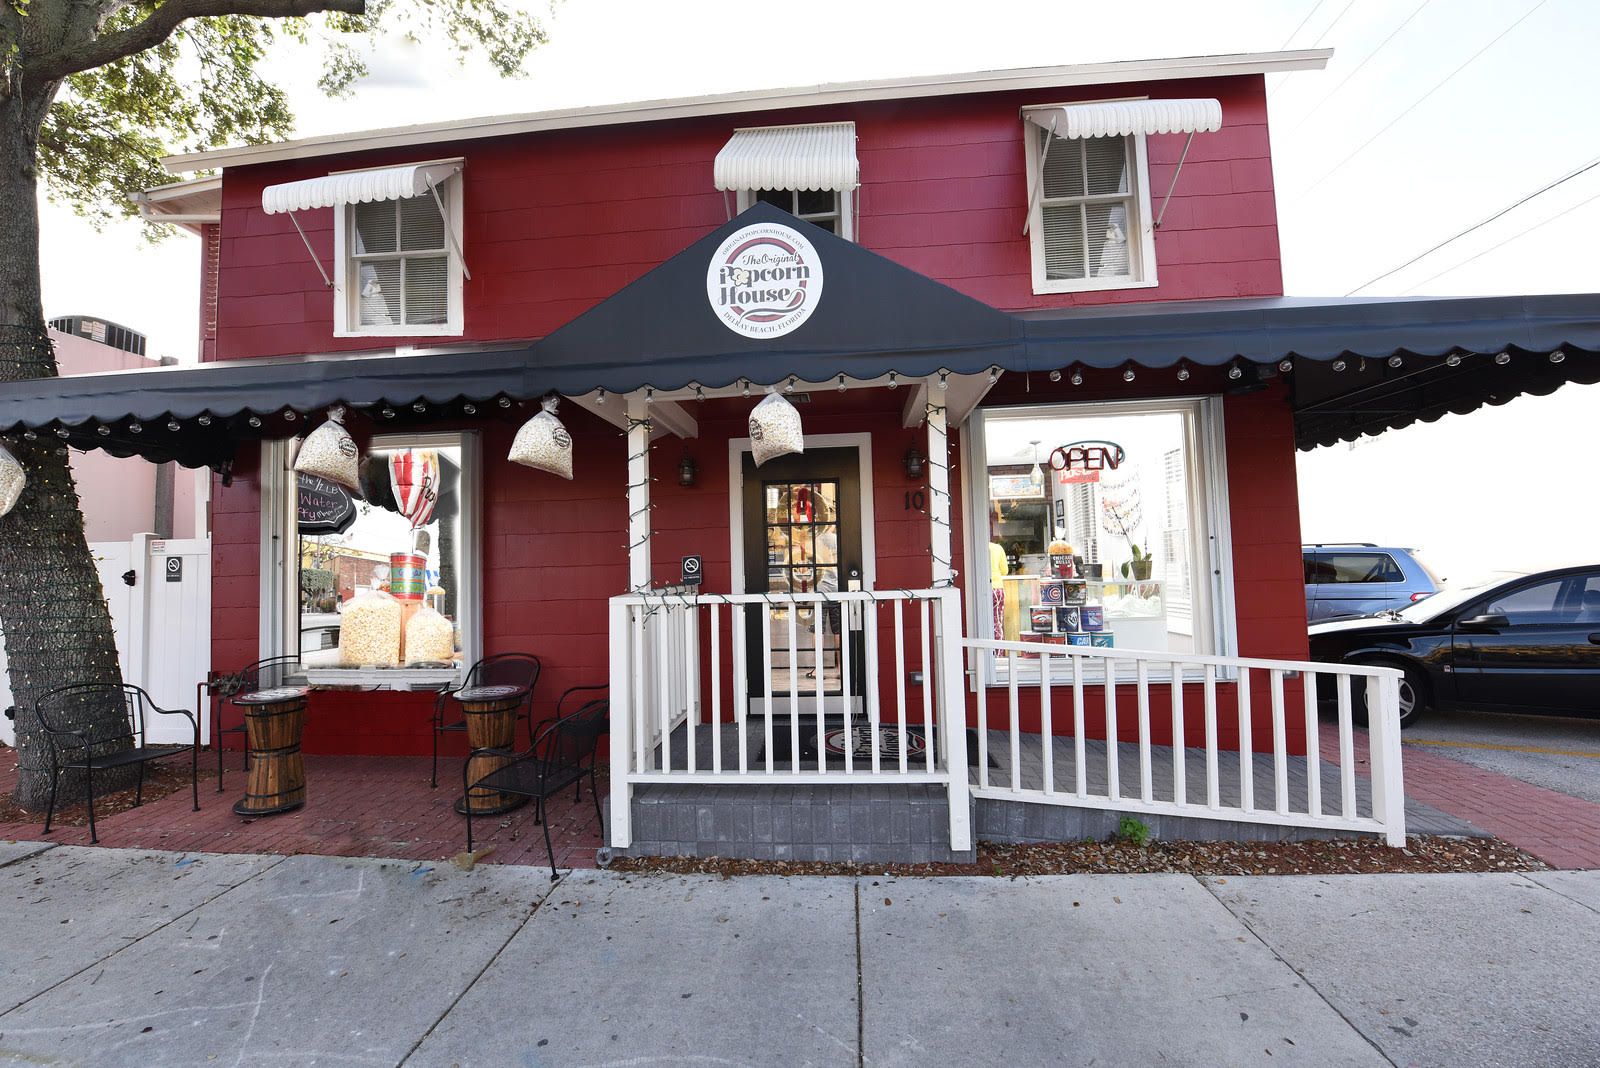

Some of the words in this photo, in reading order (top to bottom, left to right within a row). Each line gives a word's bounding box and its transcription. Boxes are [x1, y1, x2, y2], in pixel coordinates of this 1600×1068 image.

[742, 254, 761, 266] The
[761, 250, 800, 266] Original
[718, 286, 791, 306] House
[723, 311, 750, 331] DELRAY
[778, 307, 807, 330] FLORIDA
[1050, 446, 1120, 471] OPEN
[300, 491, 338, 509] Water
[904, 490, 924, 511] 10
